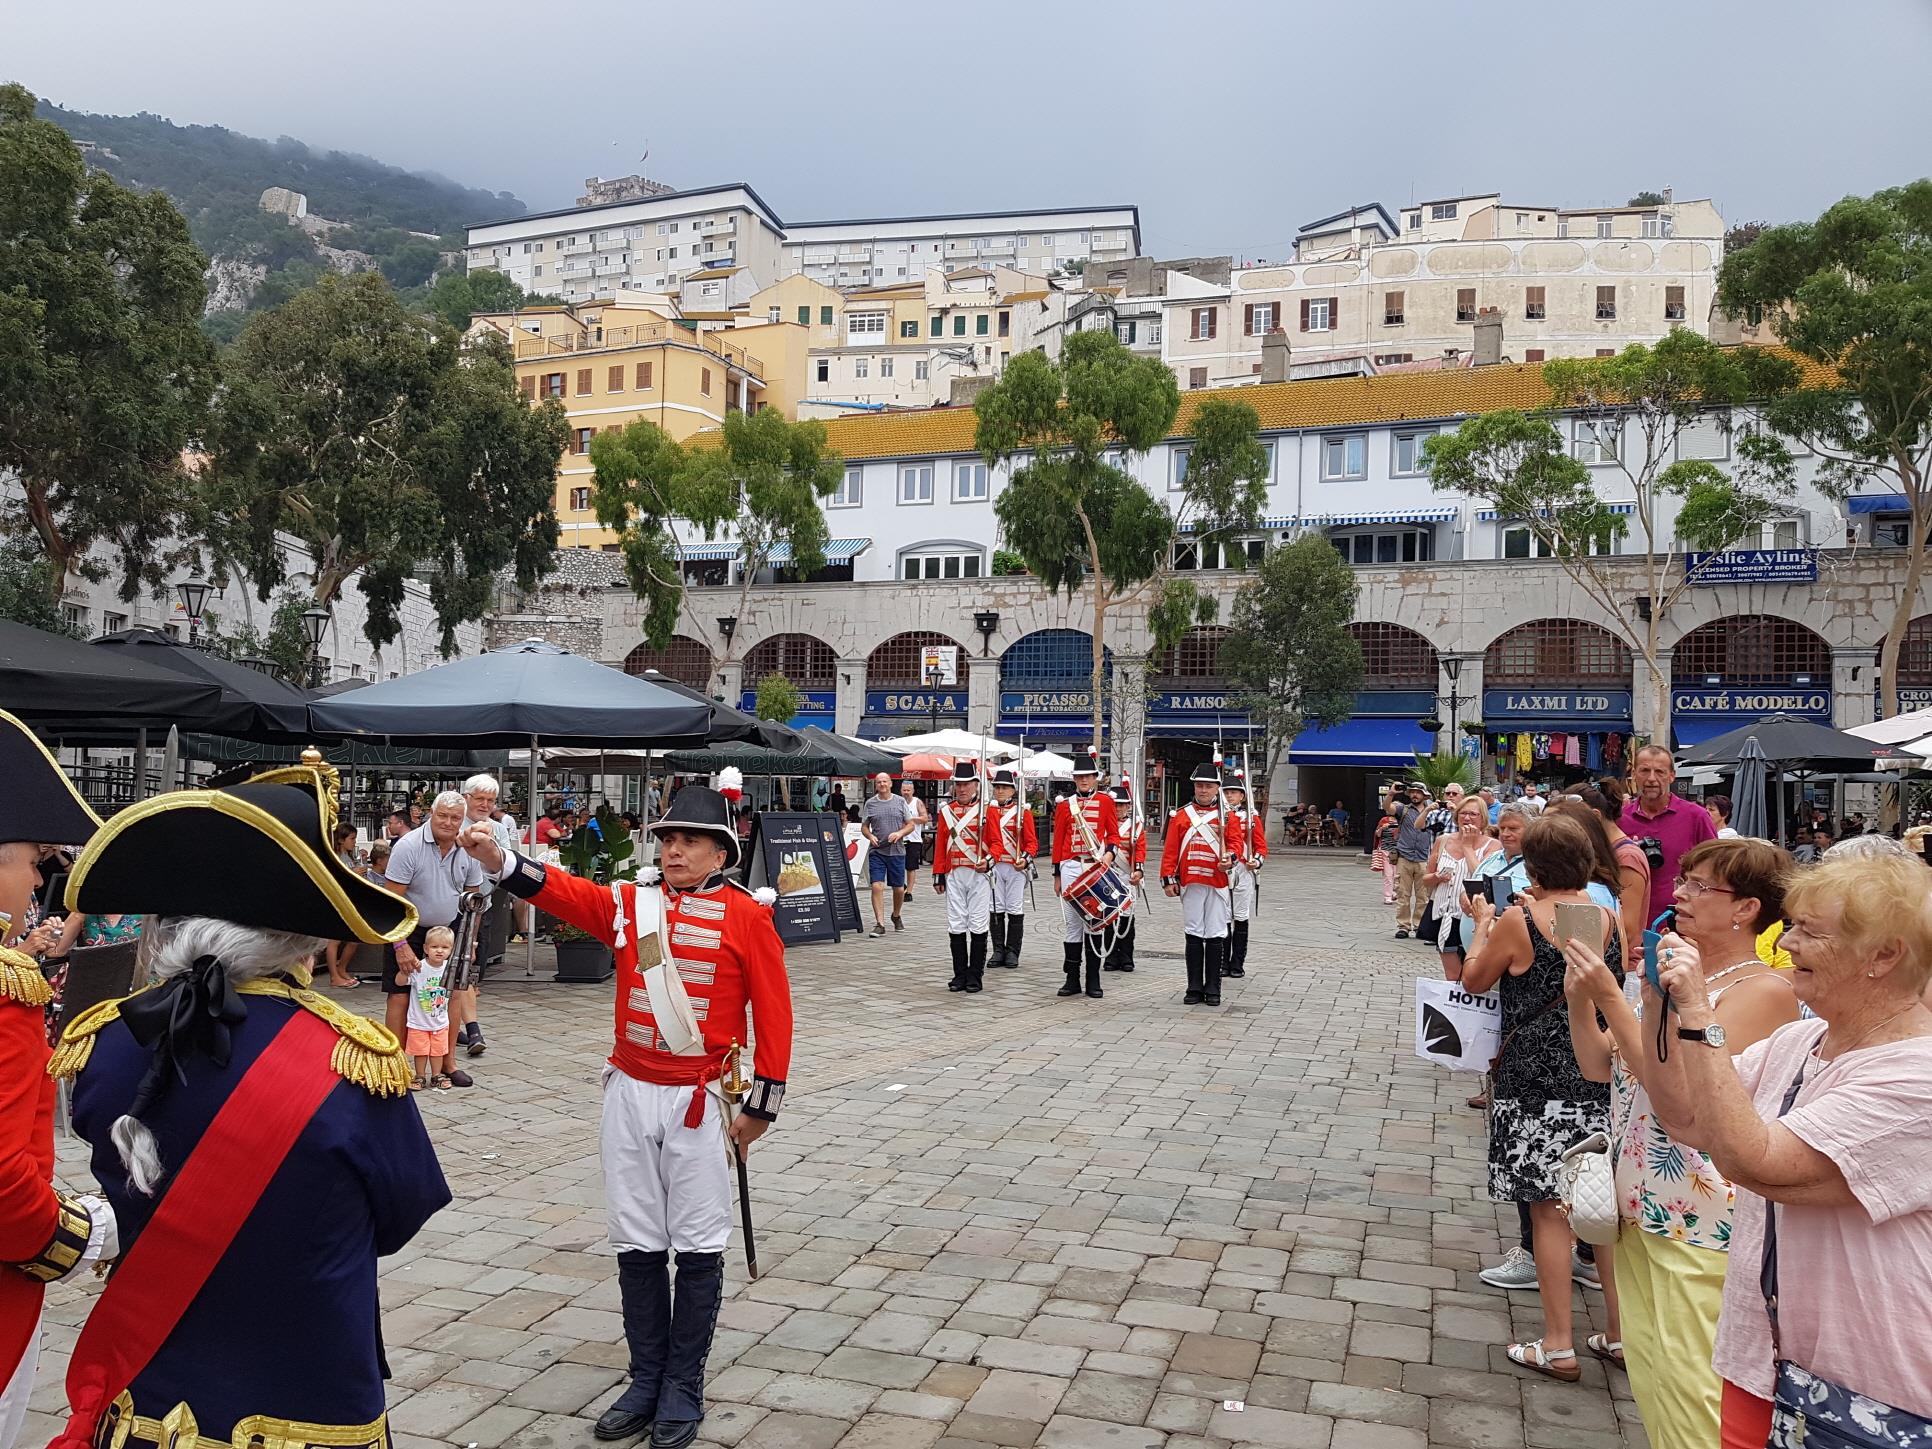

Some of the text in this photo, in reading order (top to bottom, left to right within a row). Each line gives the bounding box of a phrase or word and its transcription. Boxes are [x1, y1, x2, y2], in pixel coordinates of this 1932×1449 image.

[1750, 550, 1813, 566] Ayling
[885, 695, 956, 710] SCALA
[1023, 694, 1089, 706] PICASSO
[1170, 696, 1225, 709] RAMSO
[1505, 696, 1609, 710] LAXMI LTD
[1676, 691, 1826, 710] CAFÉ MODELO
[1448, 990, 1498, 1010] HOTU
